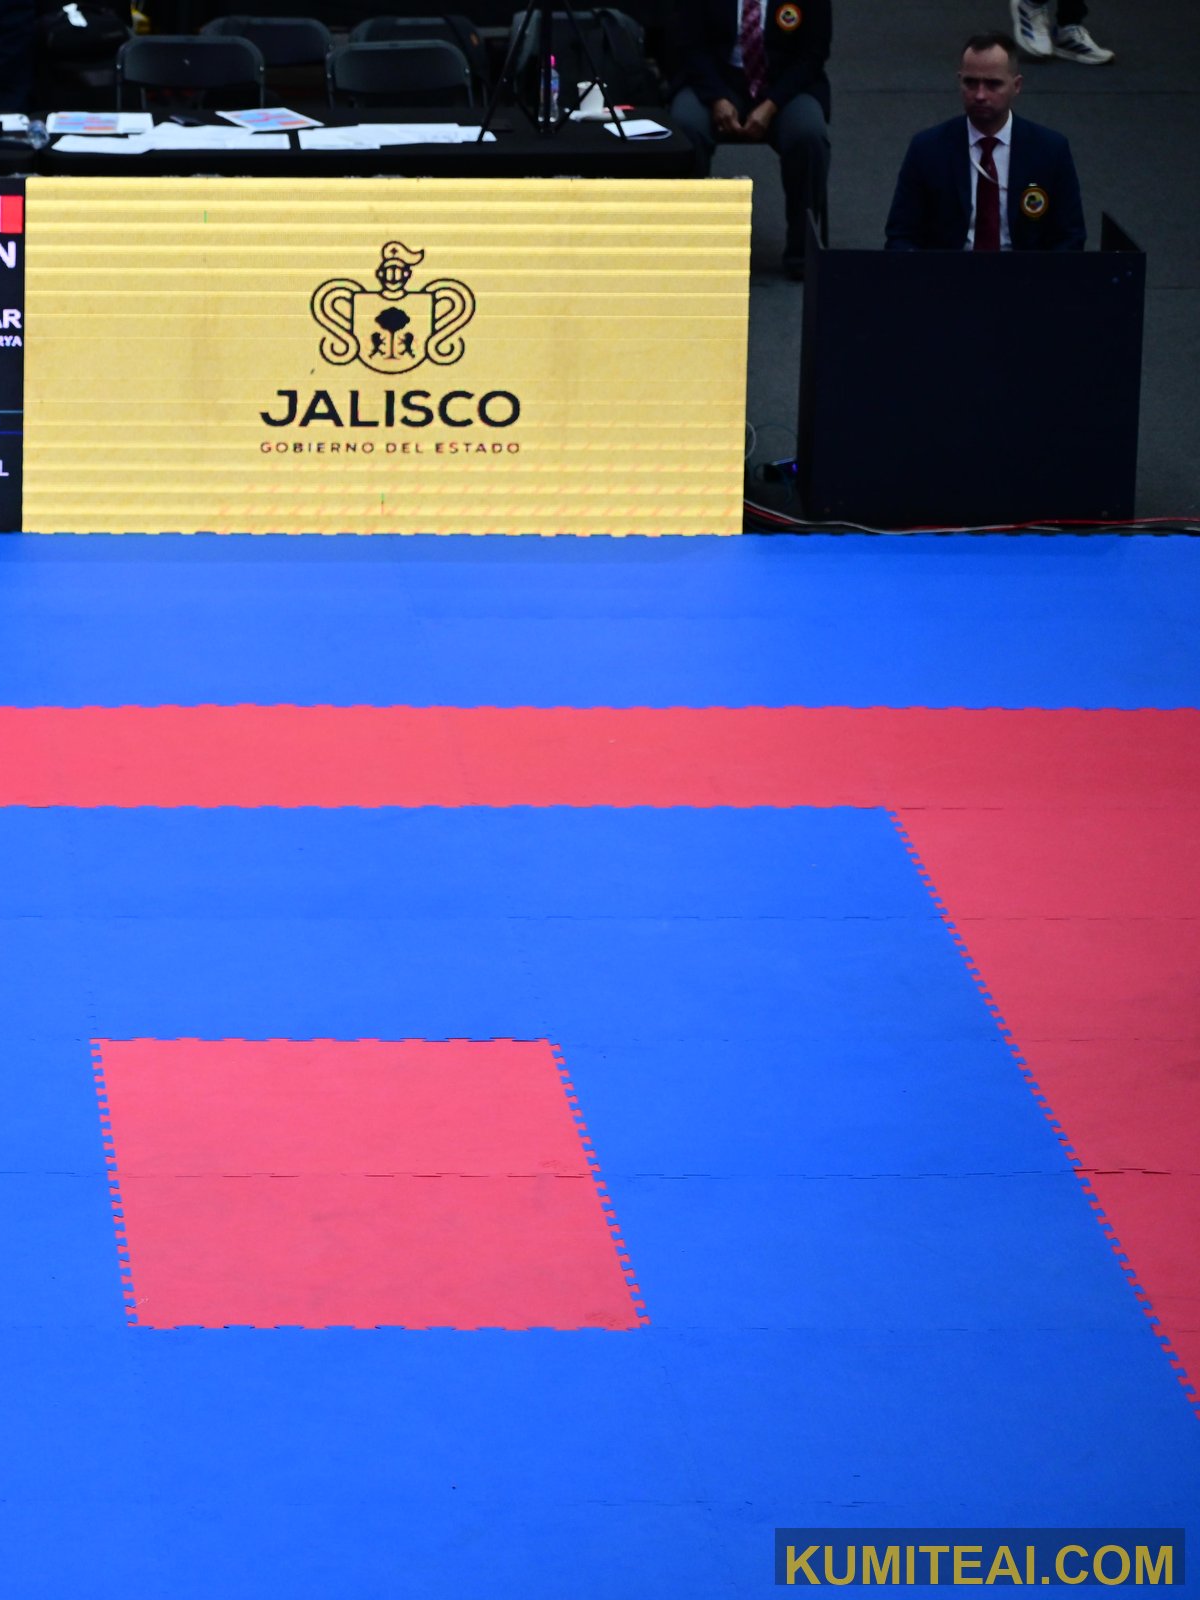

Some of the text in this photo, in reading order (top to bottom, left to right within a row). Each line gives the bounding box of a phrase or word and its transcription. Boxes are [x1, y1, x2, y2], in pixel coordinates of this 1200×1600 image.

[260, 390, 520, 427] JALISCO
[260, 442, 520, 454] GOBIERNO DEL ESTADO
